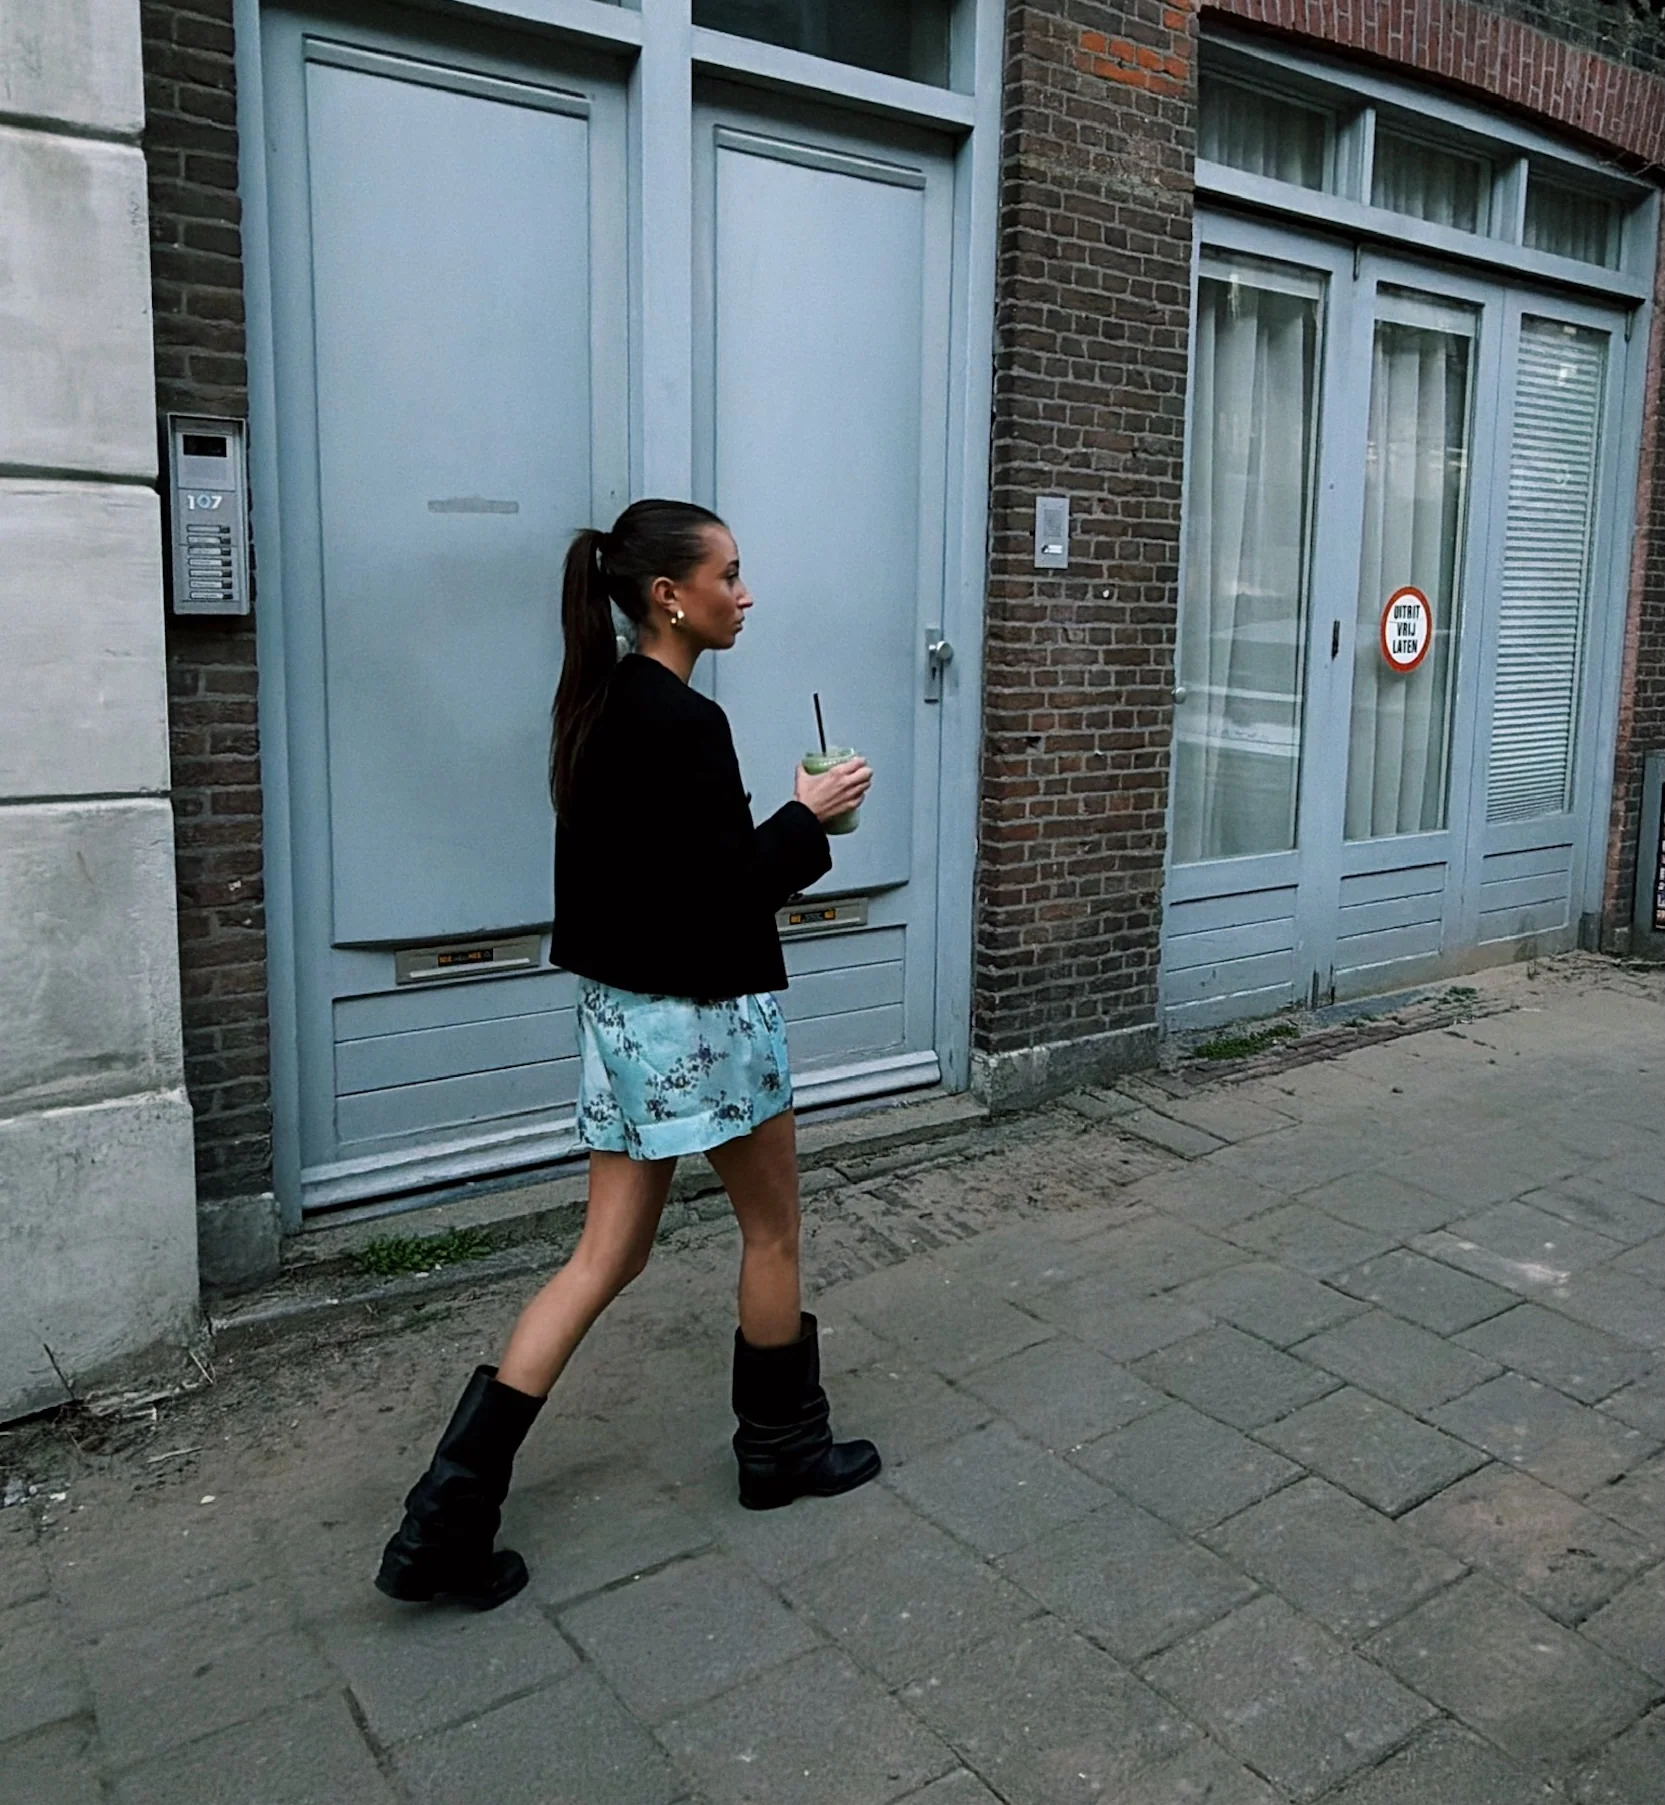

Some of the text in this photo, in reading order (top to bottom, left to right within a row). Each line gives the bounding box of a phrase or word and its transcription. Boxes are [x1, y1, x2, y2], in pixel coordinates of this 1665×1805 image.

[187, 495, 223, 509] 107
[1394, 605, 1420, 619] UITRIT
[1397, 622, 1416, 636] VRIJ
[1393, 640, 1417, 653] LATEN
